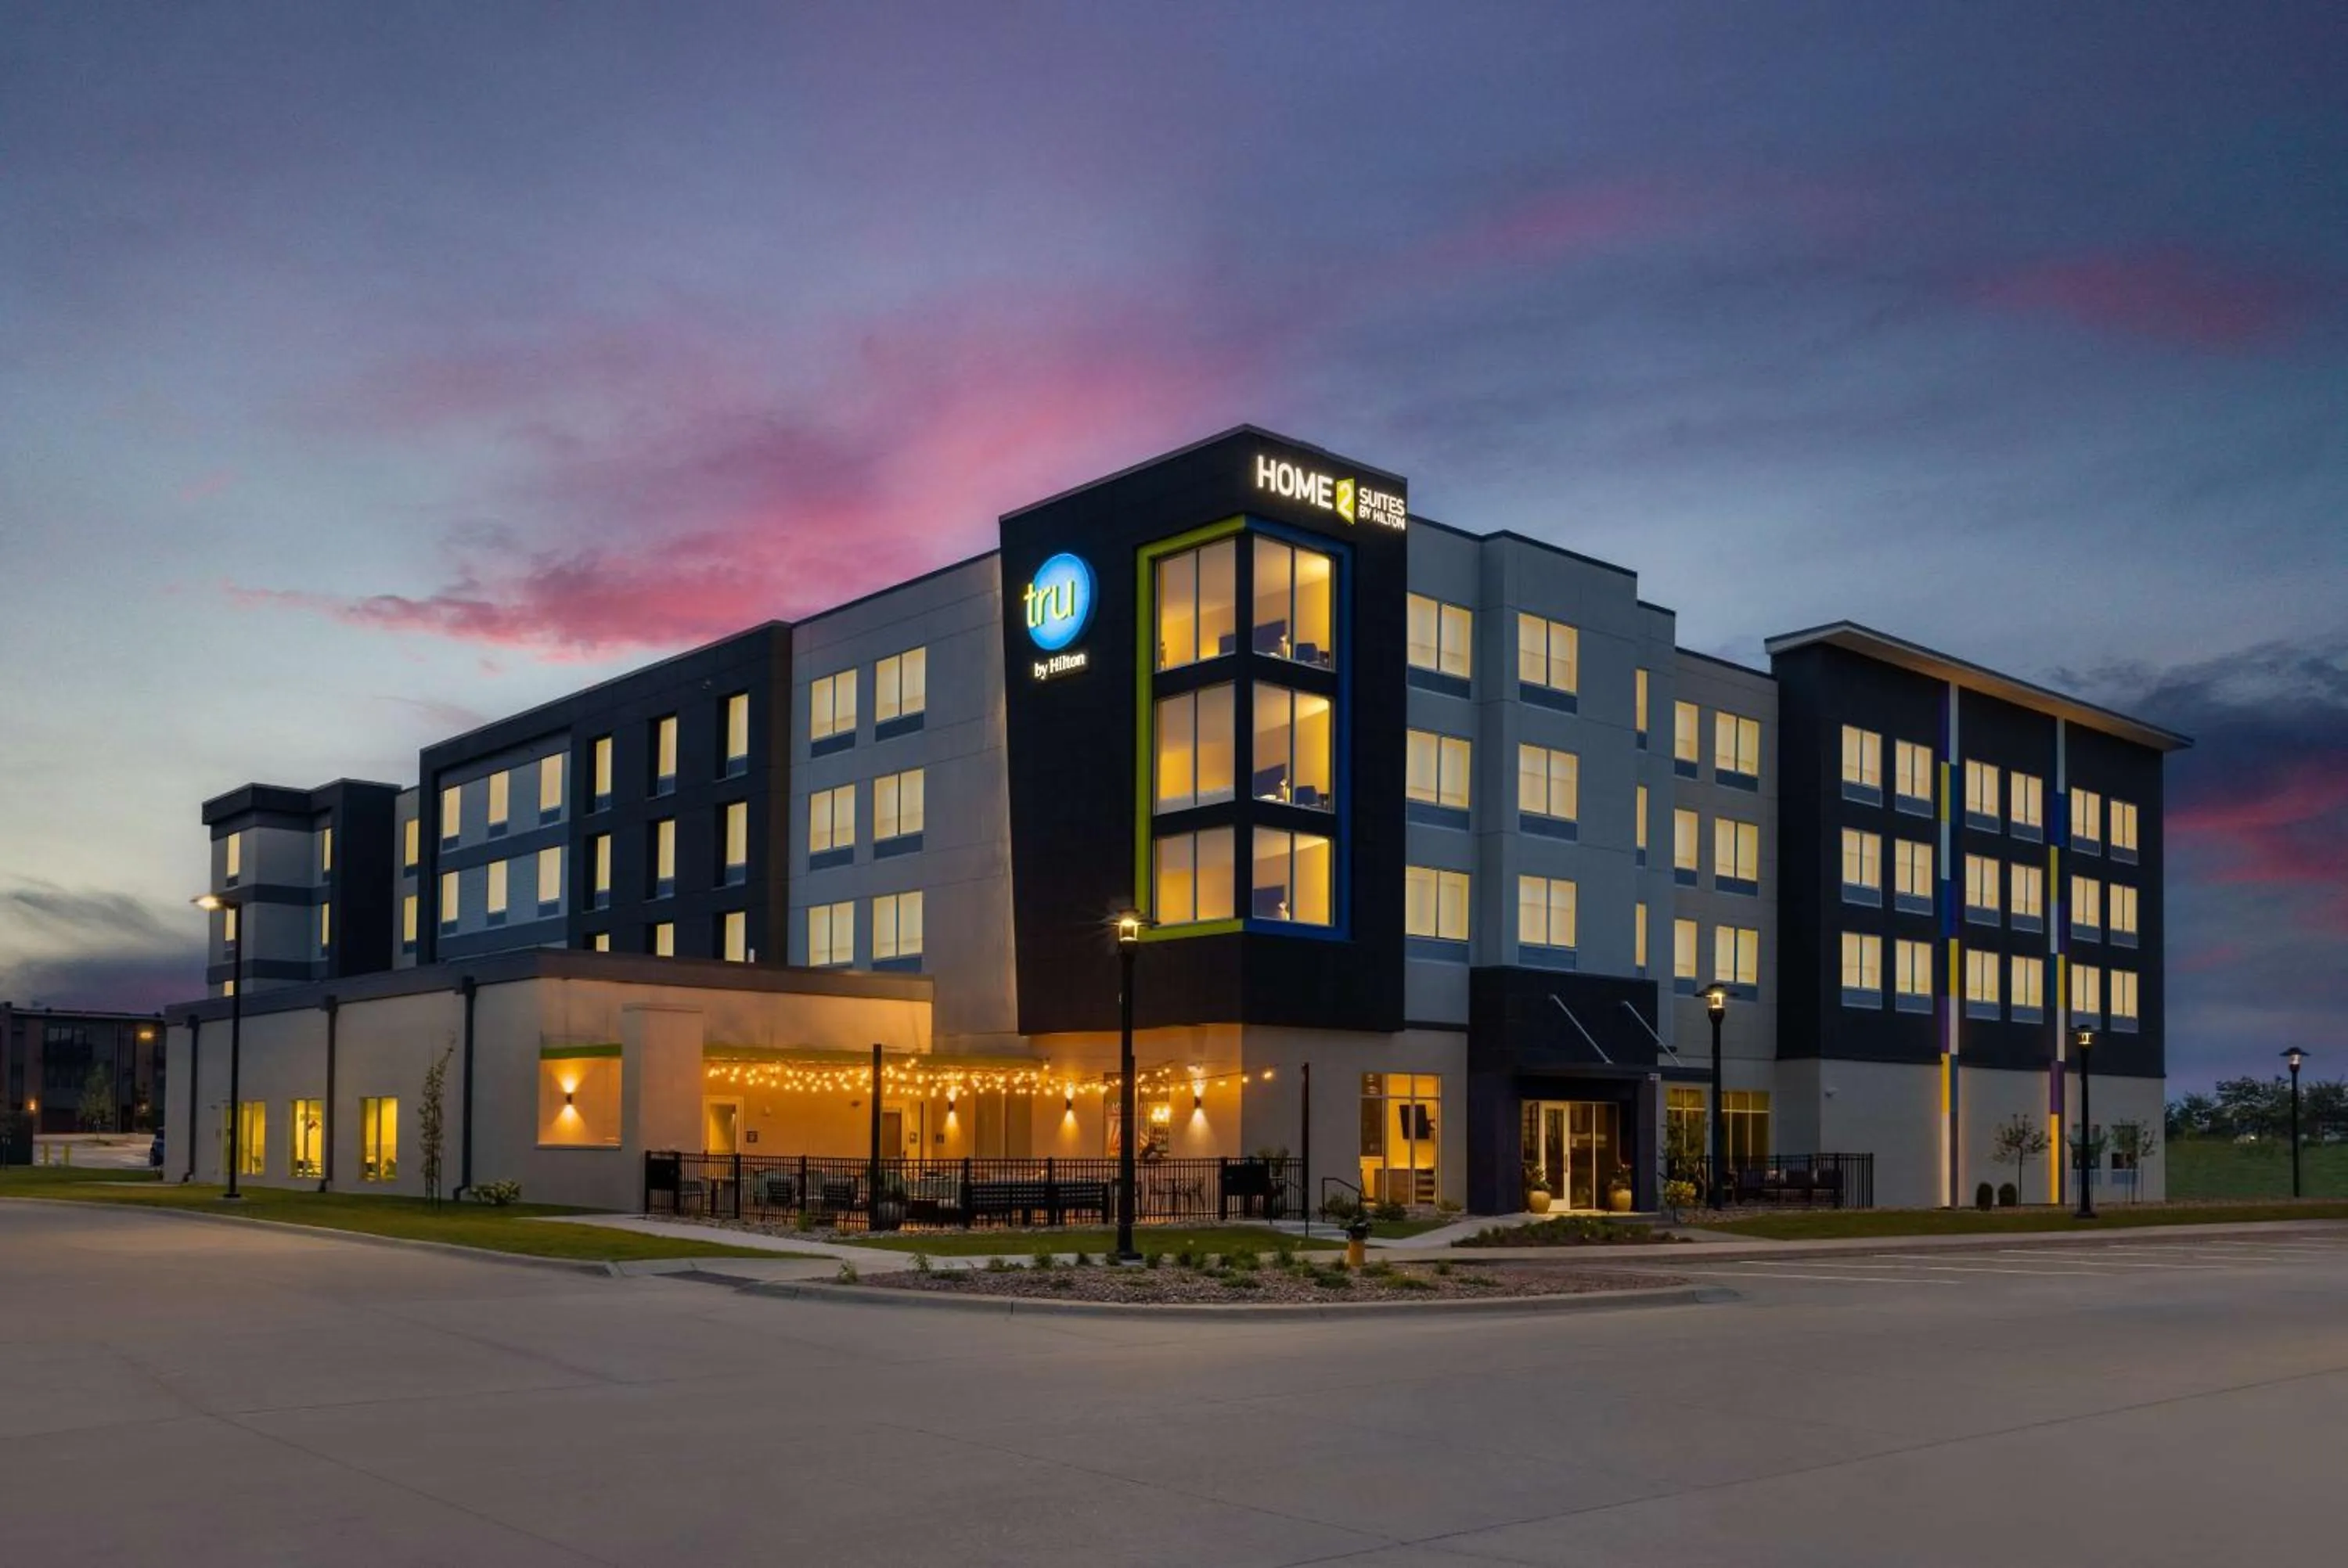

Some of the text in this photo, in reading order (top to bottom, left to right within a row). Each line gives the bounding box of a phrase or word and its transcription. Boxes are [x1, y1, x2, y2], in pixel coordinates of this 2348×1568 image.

[1257, 455, 1353, 518] HOME 2
[1359, 487, 1405, 516] SUITES
[1359, 505, 1406, 530] BY HILTON
[1024, 581, 1075, 628] tru
[1034, 653, 1086, 680] by Hilton
